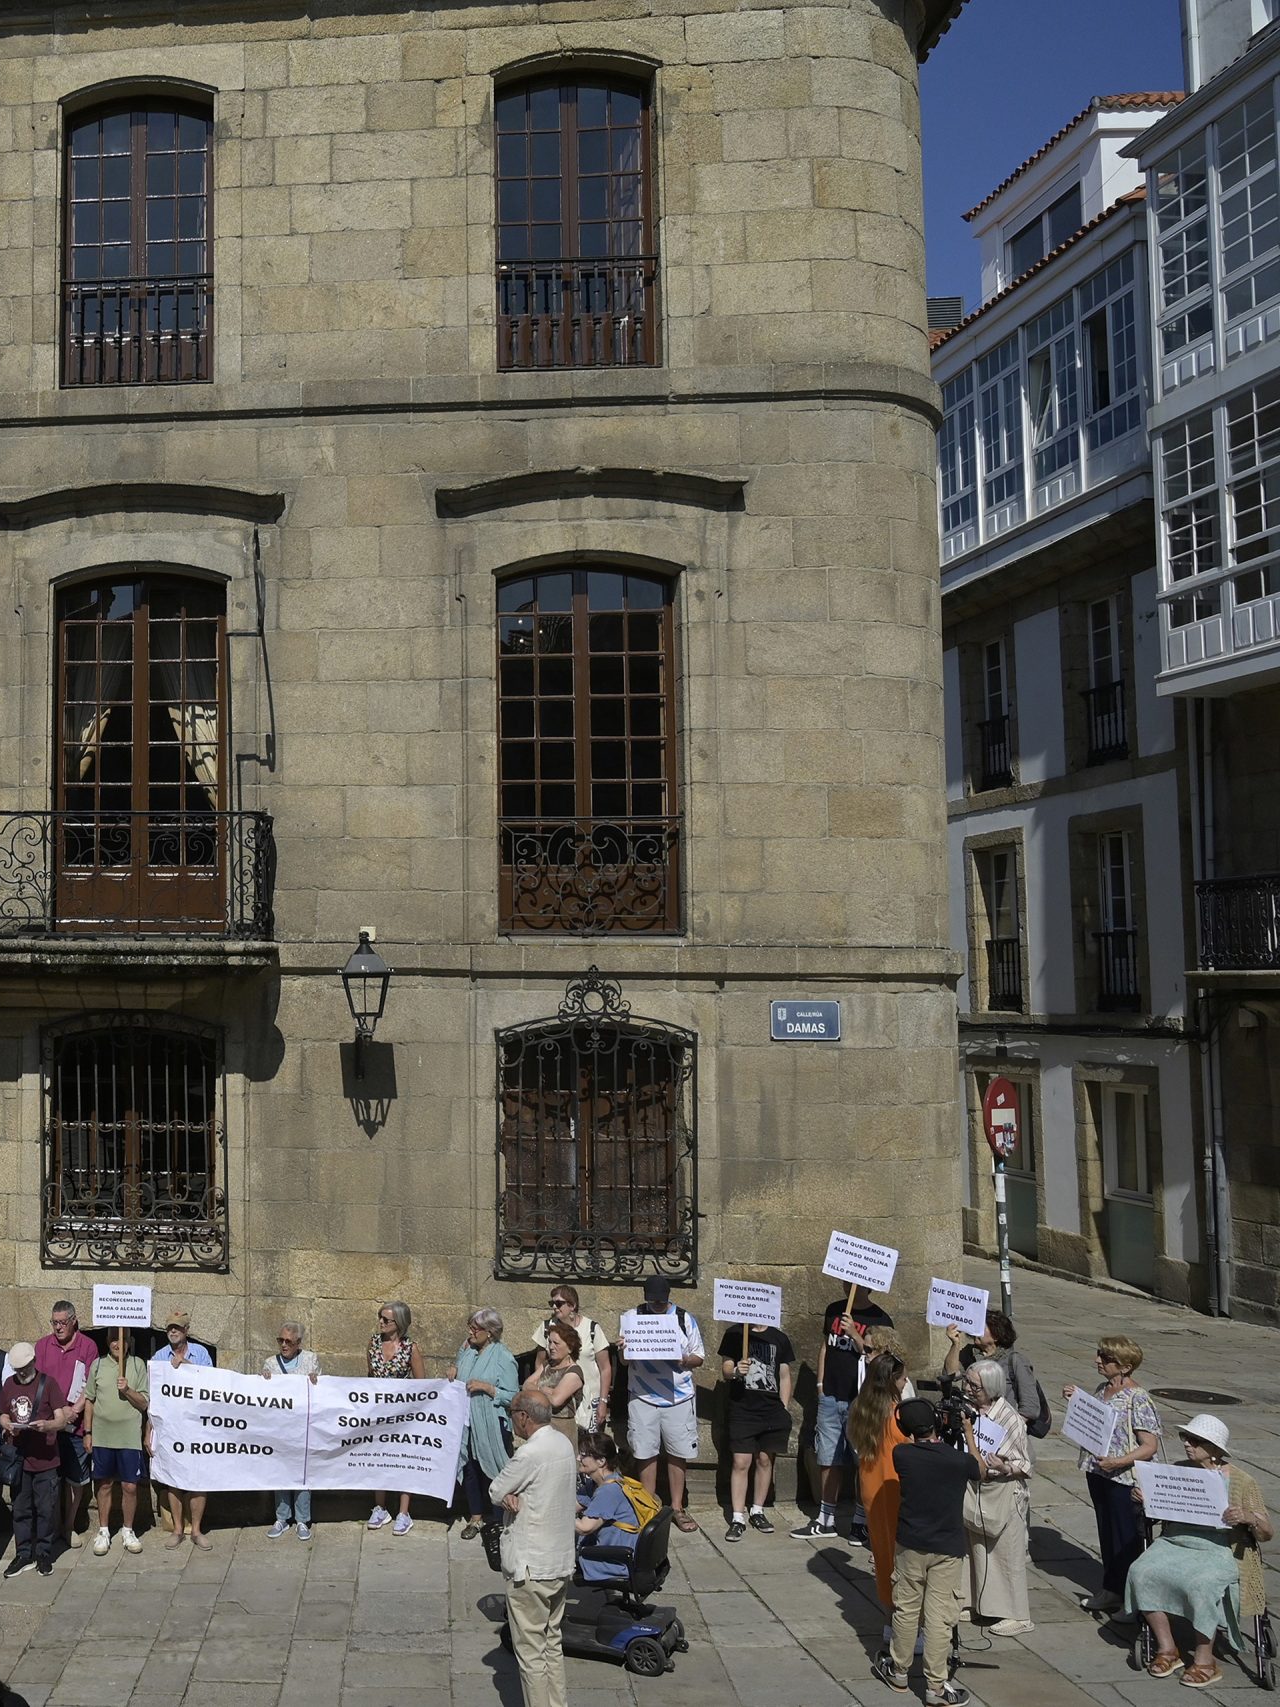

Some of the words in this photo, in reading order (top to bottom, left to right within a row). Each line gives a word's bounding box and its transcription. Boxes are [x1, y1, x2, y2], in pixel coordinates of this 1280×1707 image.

[786, 1022, 826, 1033] DAMAS
[836, 1237, 849, 1245] NON
[850, 1242, 885, 1256] QUEREMOS
[834, 1246, 862, 1259] ALFONSO
[863, 1256, 888, 1268] MOLINA
[848, 1261, 868, 1270] COMO
[827, 1264, 845, 1273] FILLO
[846, 1270, 885, 1286] PREDILECTO
[735, 1286, 769, 1294] QUEREMOS
[932, 1287, 946, 1295] QUE
[947, 1290, 981, 1304] DEVOLVAN
[946, 1302, 964, 1311] TODO
[737, 1311, 776, 1320] PREDILECTO
[941, 1312, 973, 1325] ROUBADO
[161, 1384, 194, 1399] QUE
[199, 1388, 293, 1410] DEVOLVAN
[348, 1391, 369, 1404] OS
[374, 1391, 439, 1404] FRANCO
[200, 1415, 248, 1430] TODO
[338, 1416, 371, 1428] SON
[376, 1411, 448, 1426] PERSOAS
[341, 1434, 374, 1448] NON
[378, 1433, 443, 1449] GRATAS
[173, 1441, 185, 1453] O
[190, 1442, 274, 1455] ROUBADO
[401, 1453, 432, 1462] Municipal
[1169, 1475, 1204, 1484] QUEREMOS
